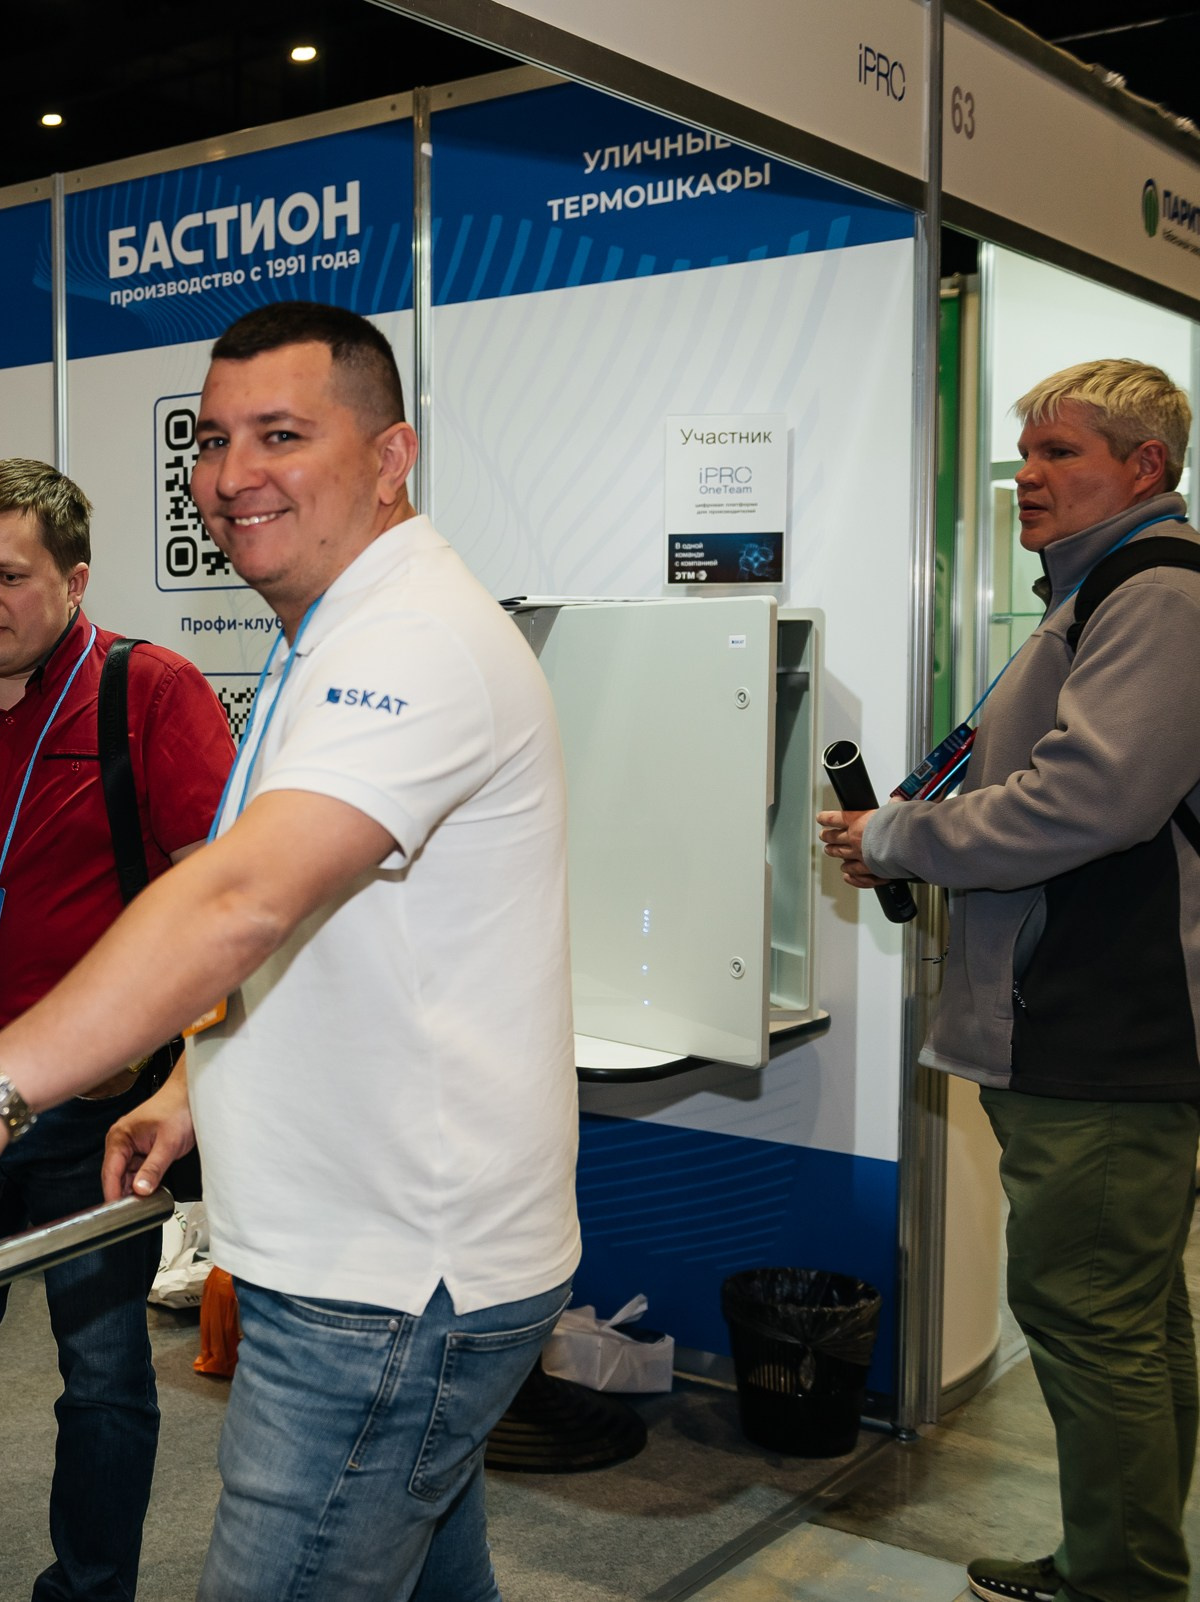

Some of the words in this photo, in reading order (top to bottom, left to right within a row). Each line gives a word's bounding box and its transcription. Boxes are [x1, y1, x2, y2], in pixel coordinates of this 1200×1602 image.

[858, 43, 905, 101] iPRO
[951, 85, 975, 140] 63
[547, 162, 771, 222] ТЕРМОШКАФЫ
[108, 180, 360, 279] БАСТИОН
[110, 269, 246, 308] производство
[250, 267, 261, 281] с
[266, 254, 305, 278] 1991
[312, 249, 360, 272] года
[680, 428, 773, 446] Участник
[699, 466, 753, 484] iPRO
[699, 485, 753, 495] OneTeam
[344, 689, 409, 716] SKAT
